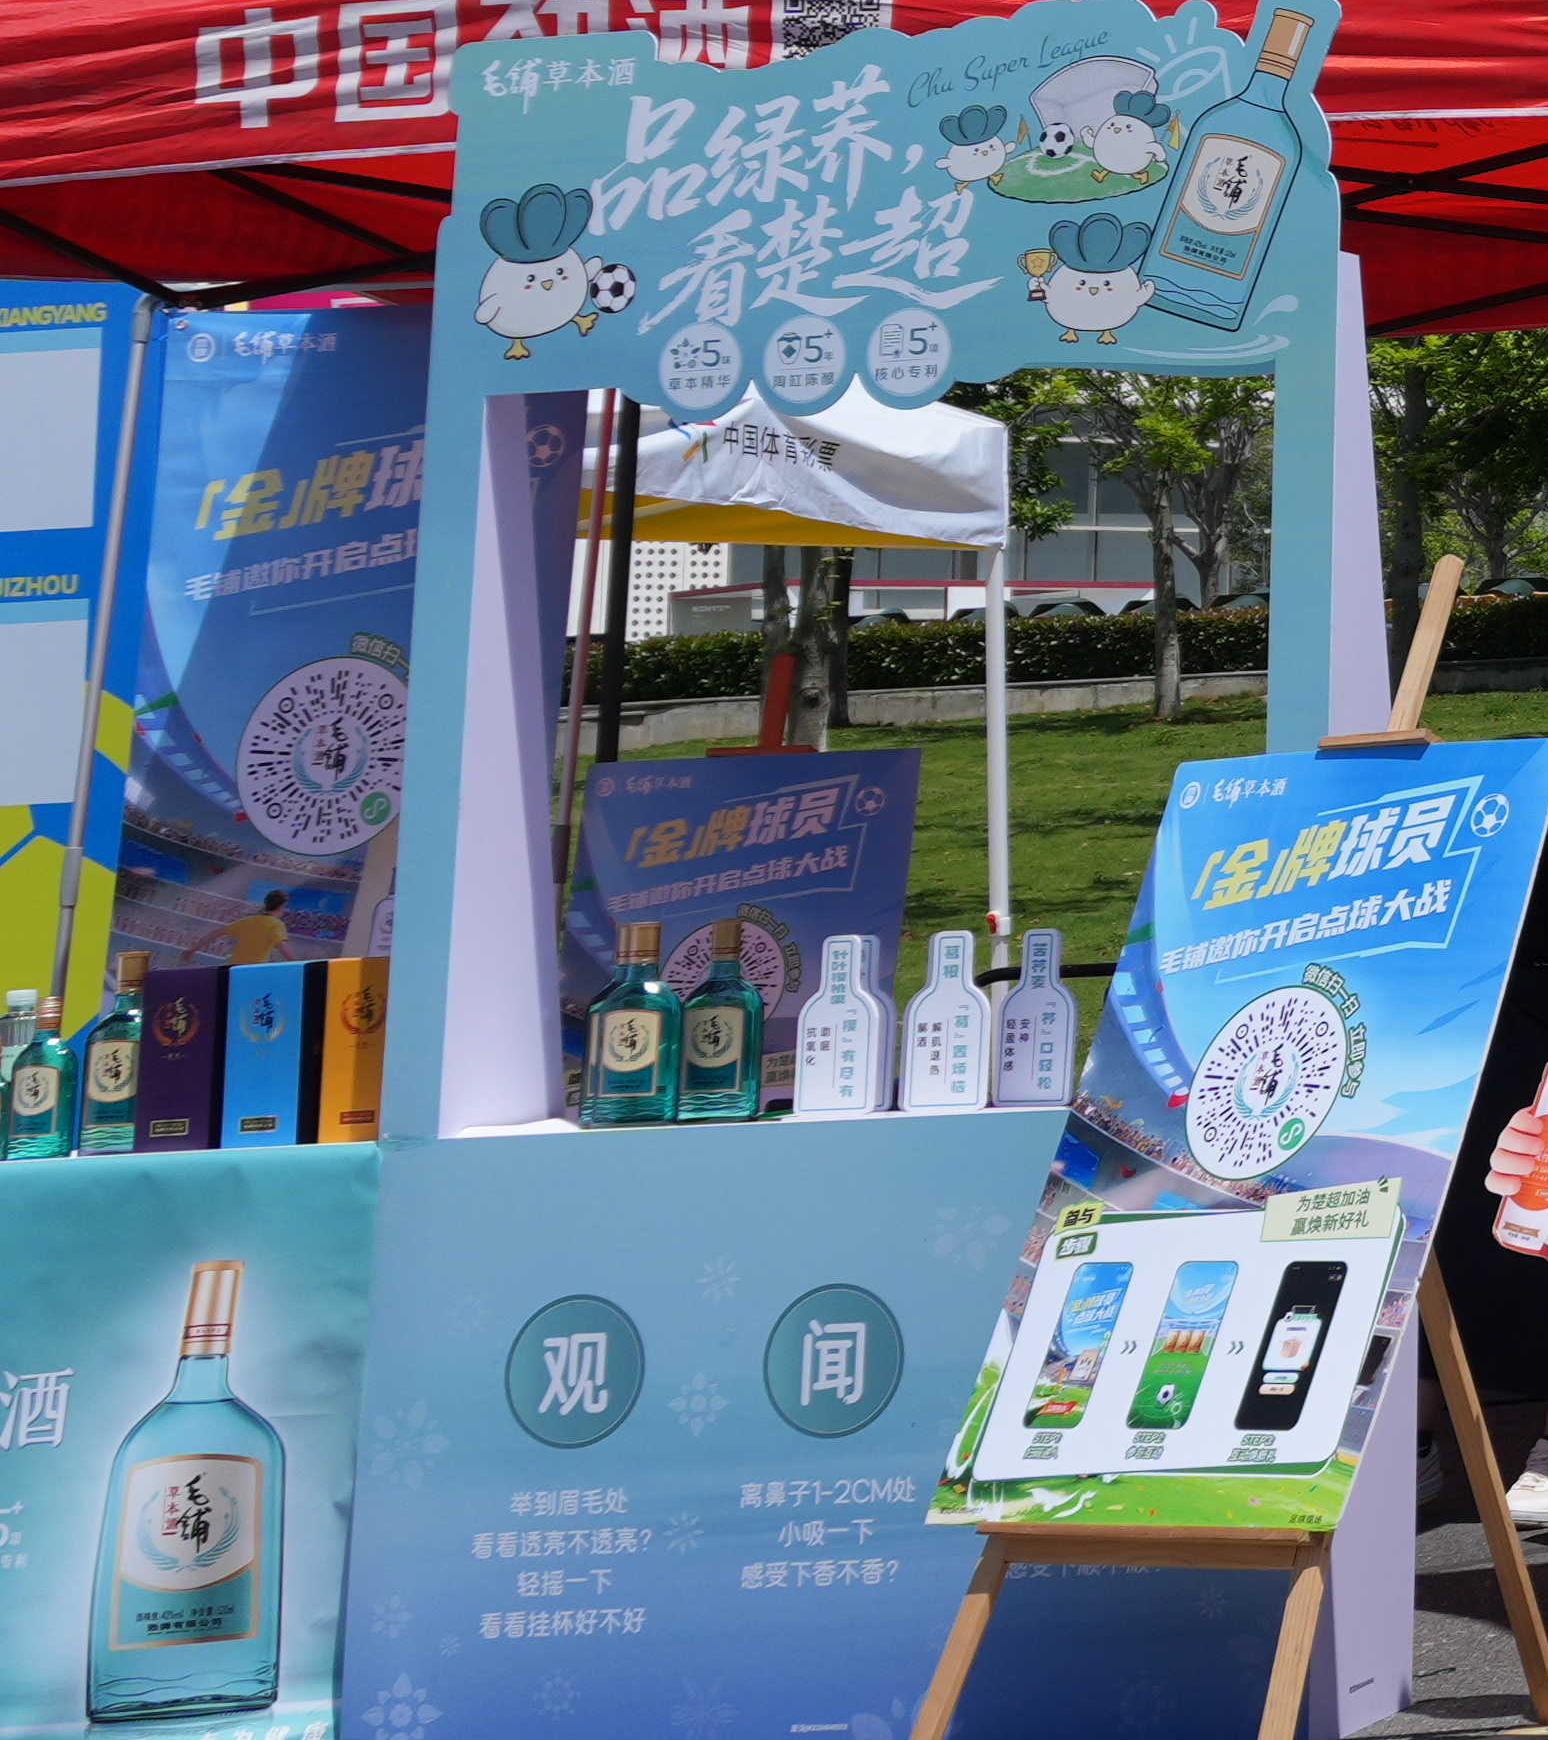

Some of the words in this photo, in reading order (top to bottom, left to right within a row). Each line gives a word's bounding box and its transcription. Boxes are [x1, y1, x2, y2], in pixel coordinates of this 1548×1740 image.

[907, 71, 957, 110] Chu
[963, 56, 1031, 92] Super
[1037, 28, 1111, 69] League
[638, 186, 1005, 336] 看楚超
[875, 363, 938, 381] 核心专利
[722, 421, 840, 473] 中国体育彩票
[1191, 793, 1458, 910] 「金」牌球员
[1160, 878, 1453, 976] 毛铺邀你开启点球大战
[1297, 1187, 1371, 1212] 为楚超加油
[538, 1330, 608, 1417] 观
[801, 1318, 866, 1407] 闻
[0, 1367, 75, 1451] 酒
[509, 1486, 629, 1517] 举到眉毛处
[738, 1476, 917, 1510] 离鼻子1-2CM处
[776, 1517, 875, 1549] 小吸一下
[516, 1568, 613, 1601] 轻摇一下
[478, 1607, 647, 1641] 看看挂杯好不好
